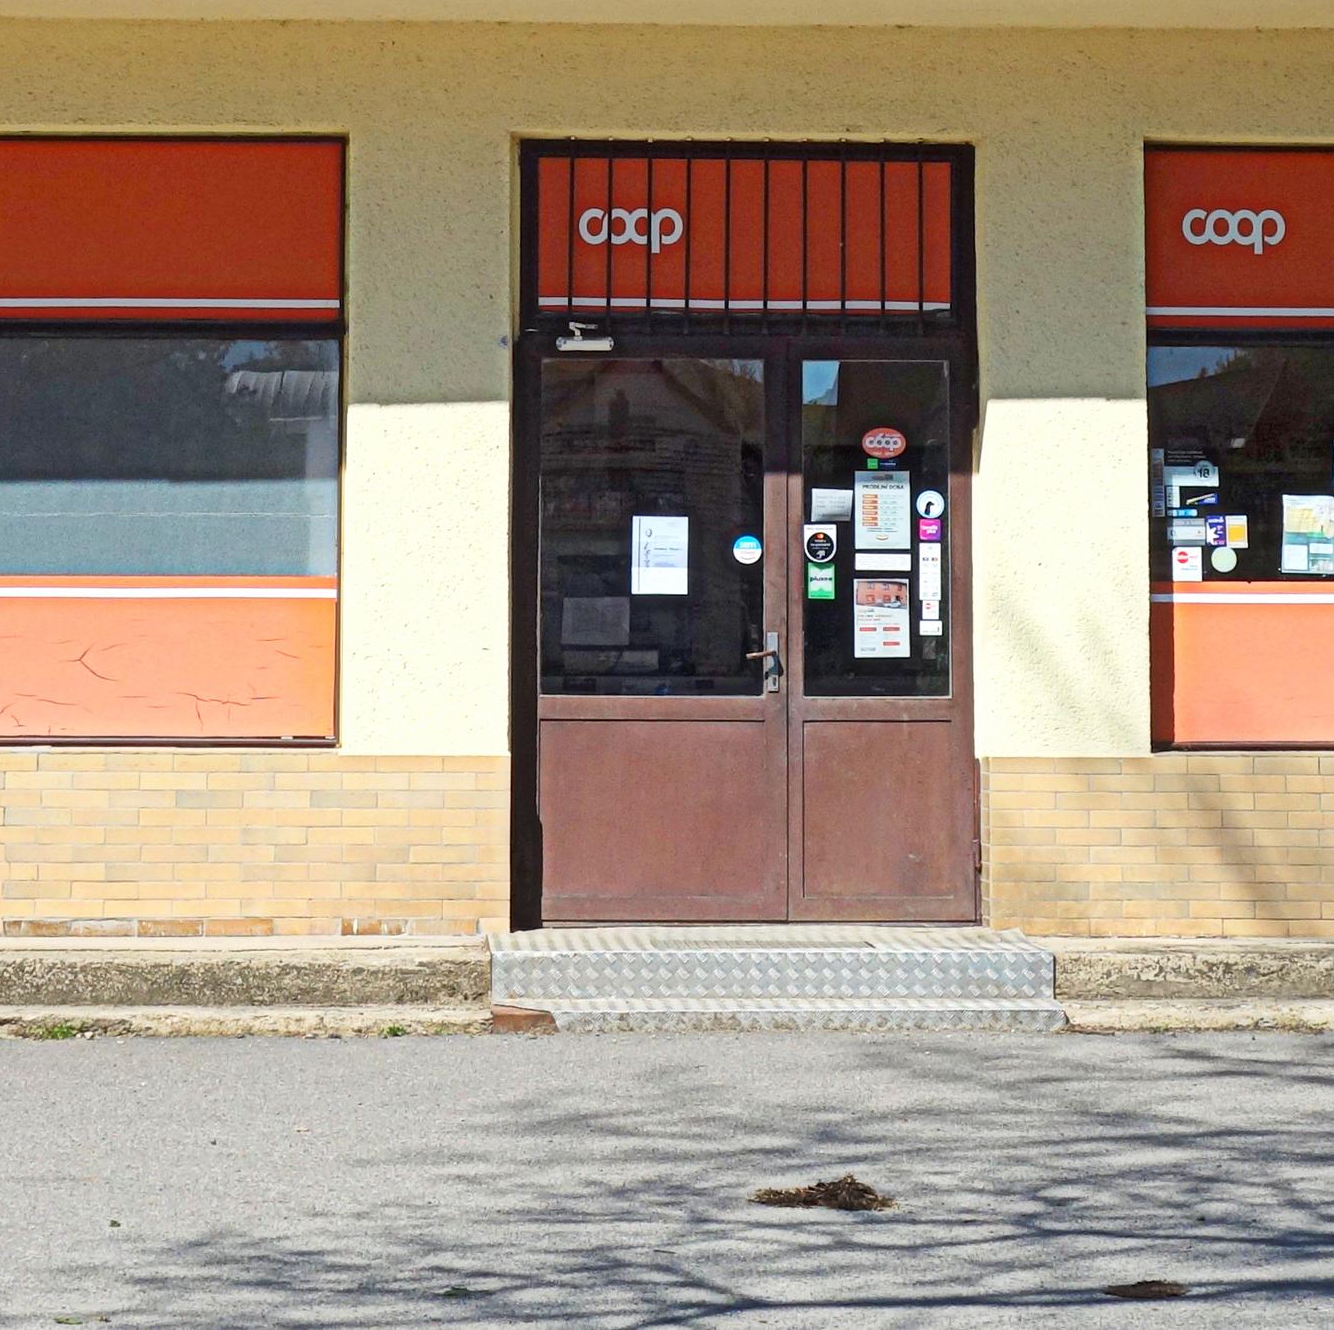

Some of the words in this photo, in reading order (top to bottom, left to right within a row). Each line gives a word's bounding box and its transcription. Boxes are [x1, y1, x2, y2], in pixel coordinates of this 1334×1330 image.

[578, 206, 684, 254] coop
[1181, 208, 1286, 255] coop
[1197, 469, 1210, 478] 18
